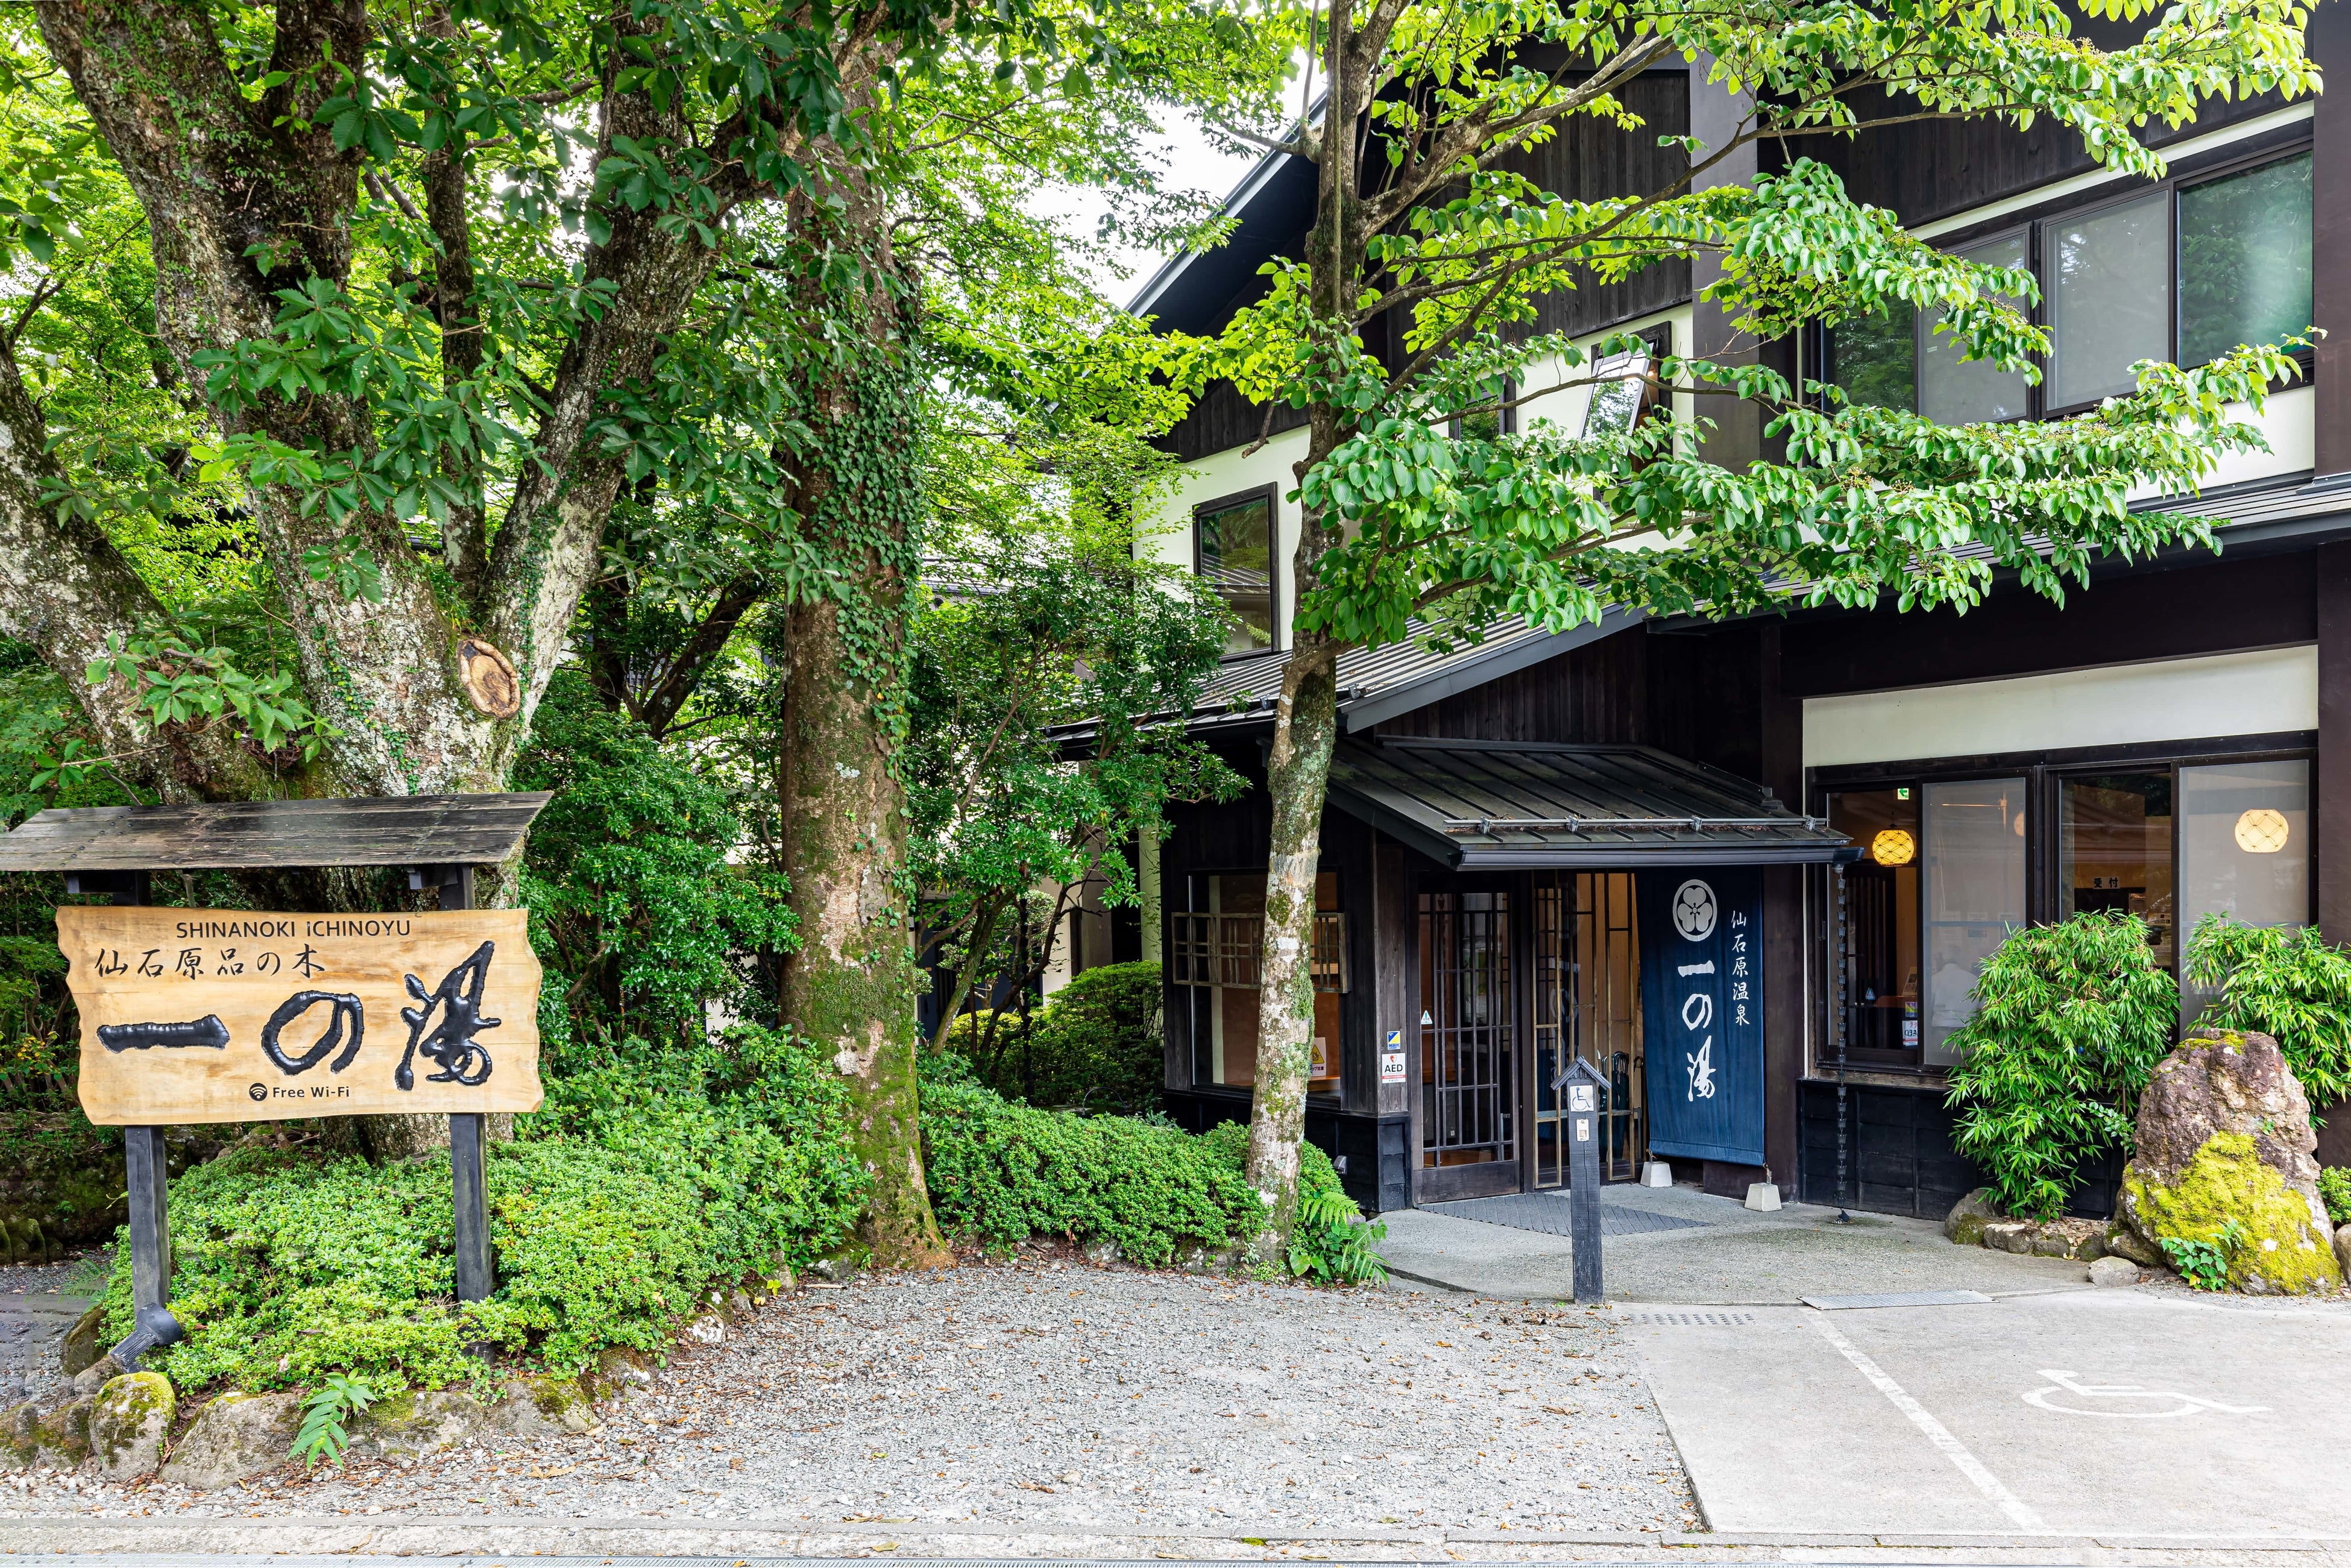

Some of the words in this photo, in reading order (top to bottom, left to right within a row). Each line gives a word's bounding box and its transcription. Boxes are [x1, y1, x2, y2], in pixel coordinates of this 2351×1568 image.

[2094, 877, 2118, 888] 受付
[176, 921, 295, 939] SHINANOKI
[306, 920, 411, 937] ICHINOYU
[95, 943, 326, 979] 仙石原品の木
[1731, 910, 1749, 1026] 仙石原温泉
[96, 940, 501, 1091] 一の湯
[1678, 960, 1716, 1101] 一の湯
[1385, 1064, 1403, 1072] AED
[272, 1087, 306, 1099] Free
[311, 1086, 350, 1098] Wi-Fi
